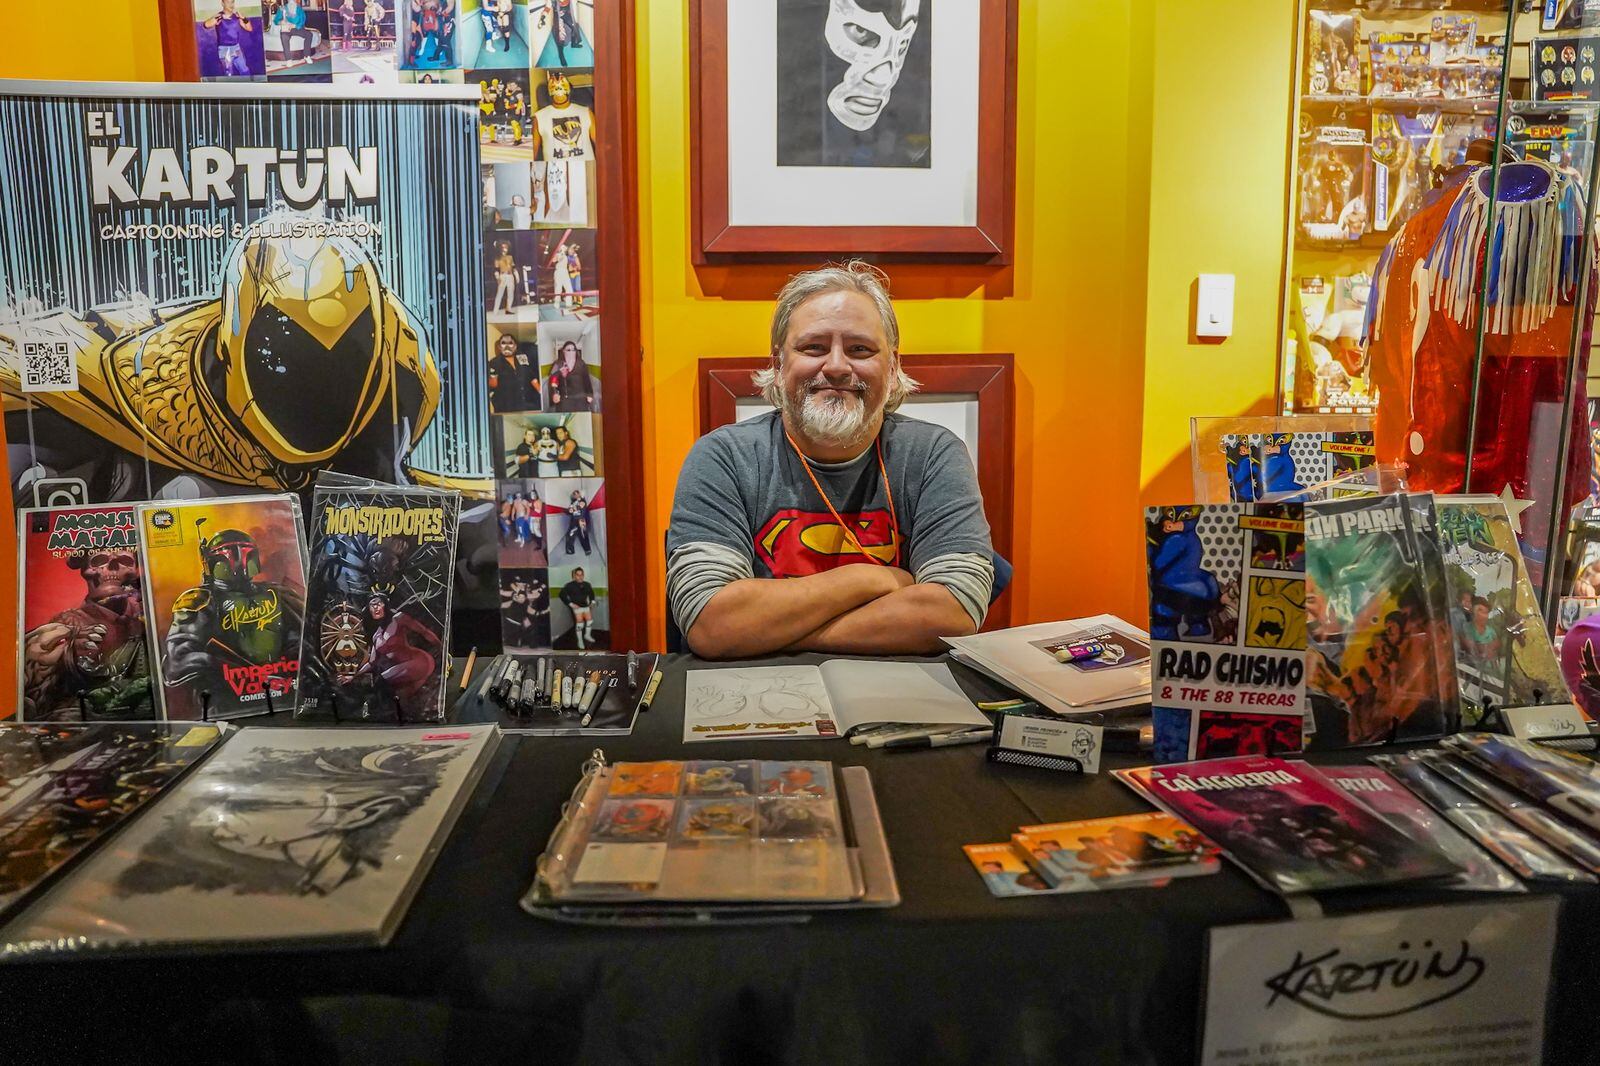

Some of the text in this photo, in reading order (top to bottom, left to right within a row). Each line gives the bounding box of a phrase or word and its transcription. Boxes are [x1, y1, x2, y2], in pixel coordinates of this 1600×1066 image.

[87, 111, 121, 137] EL
[90, 145, 378, 206] KARTÜN
[101, 220, 382, 241] CARTOONING & ILLUSTRATION
[1354, 445, 1366, 453] ONE
[326, 506, 443, 545] MONSTRADORES
[1249, 519, 1278, 528] VOLUME
[1279, 520, 1295, 529] ONE
[1341, 506, 1406, 535] PARK
[52, 550, 85, 559] BLOOD
[1159, 648, 1304, 688] RAD CHISMO
[240, 692, 266, 702] COMIC
[1161, 686, 1296, 707] & THE 88 TERRAS
